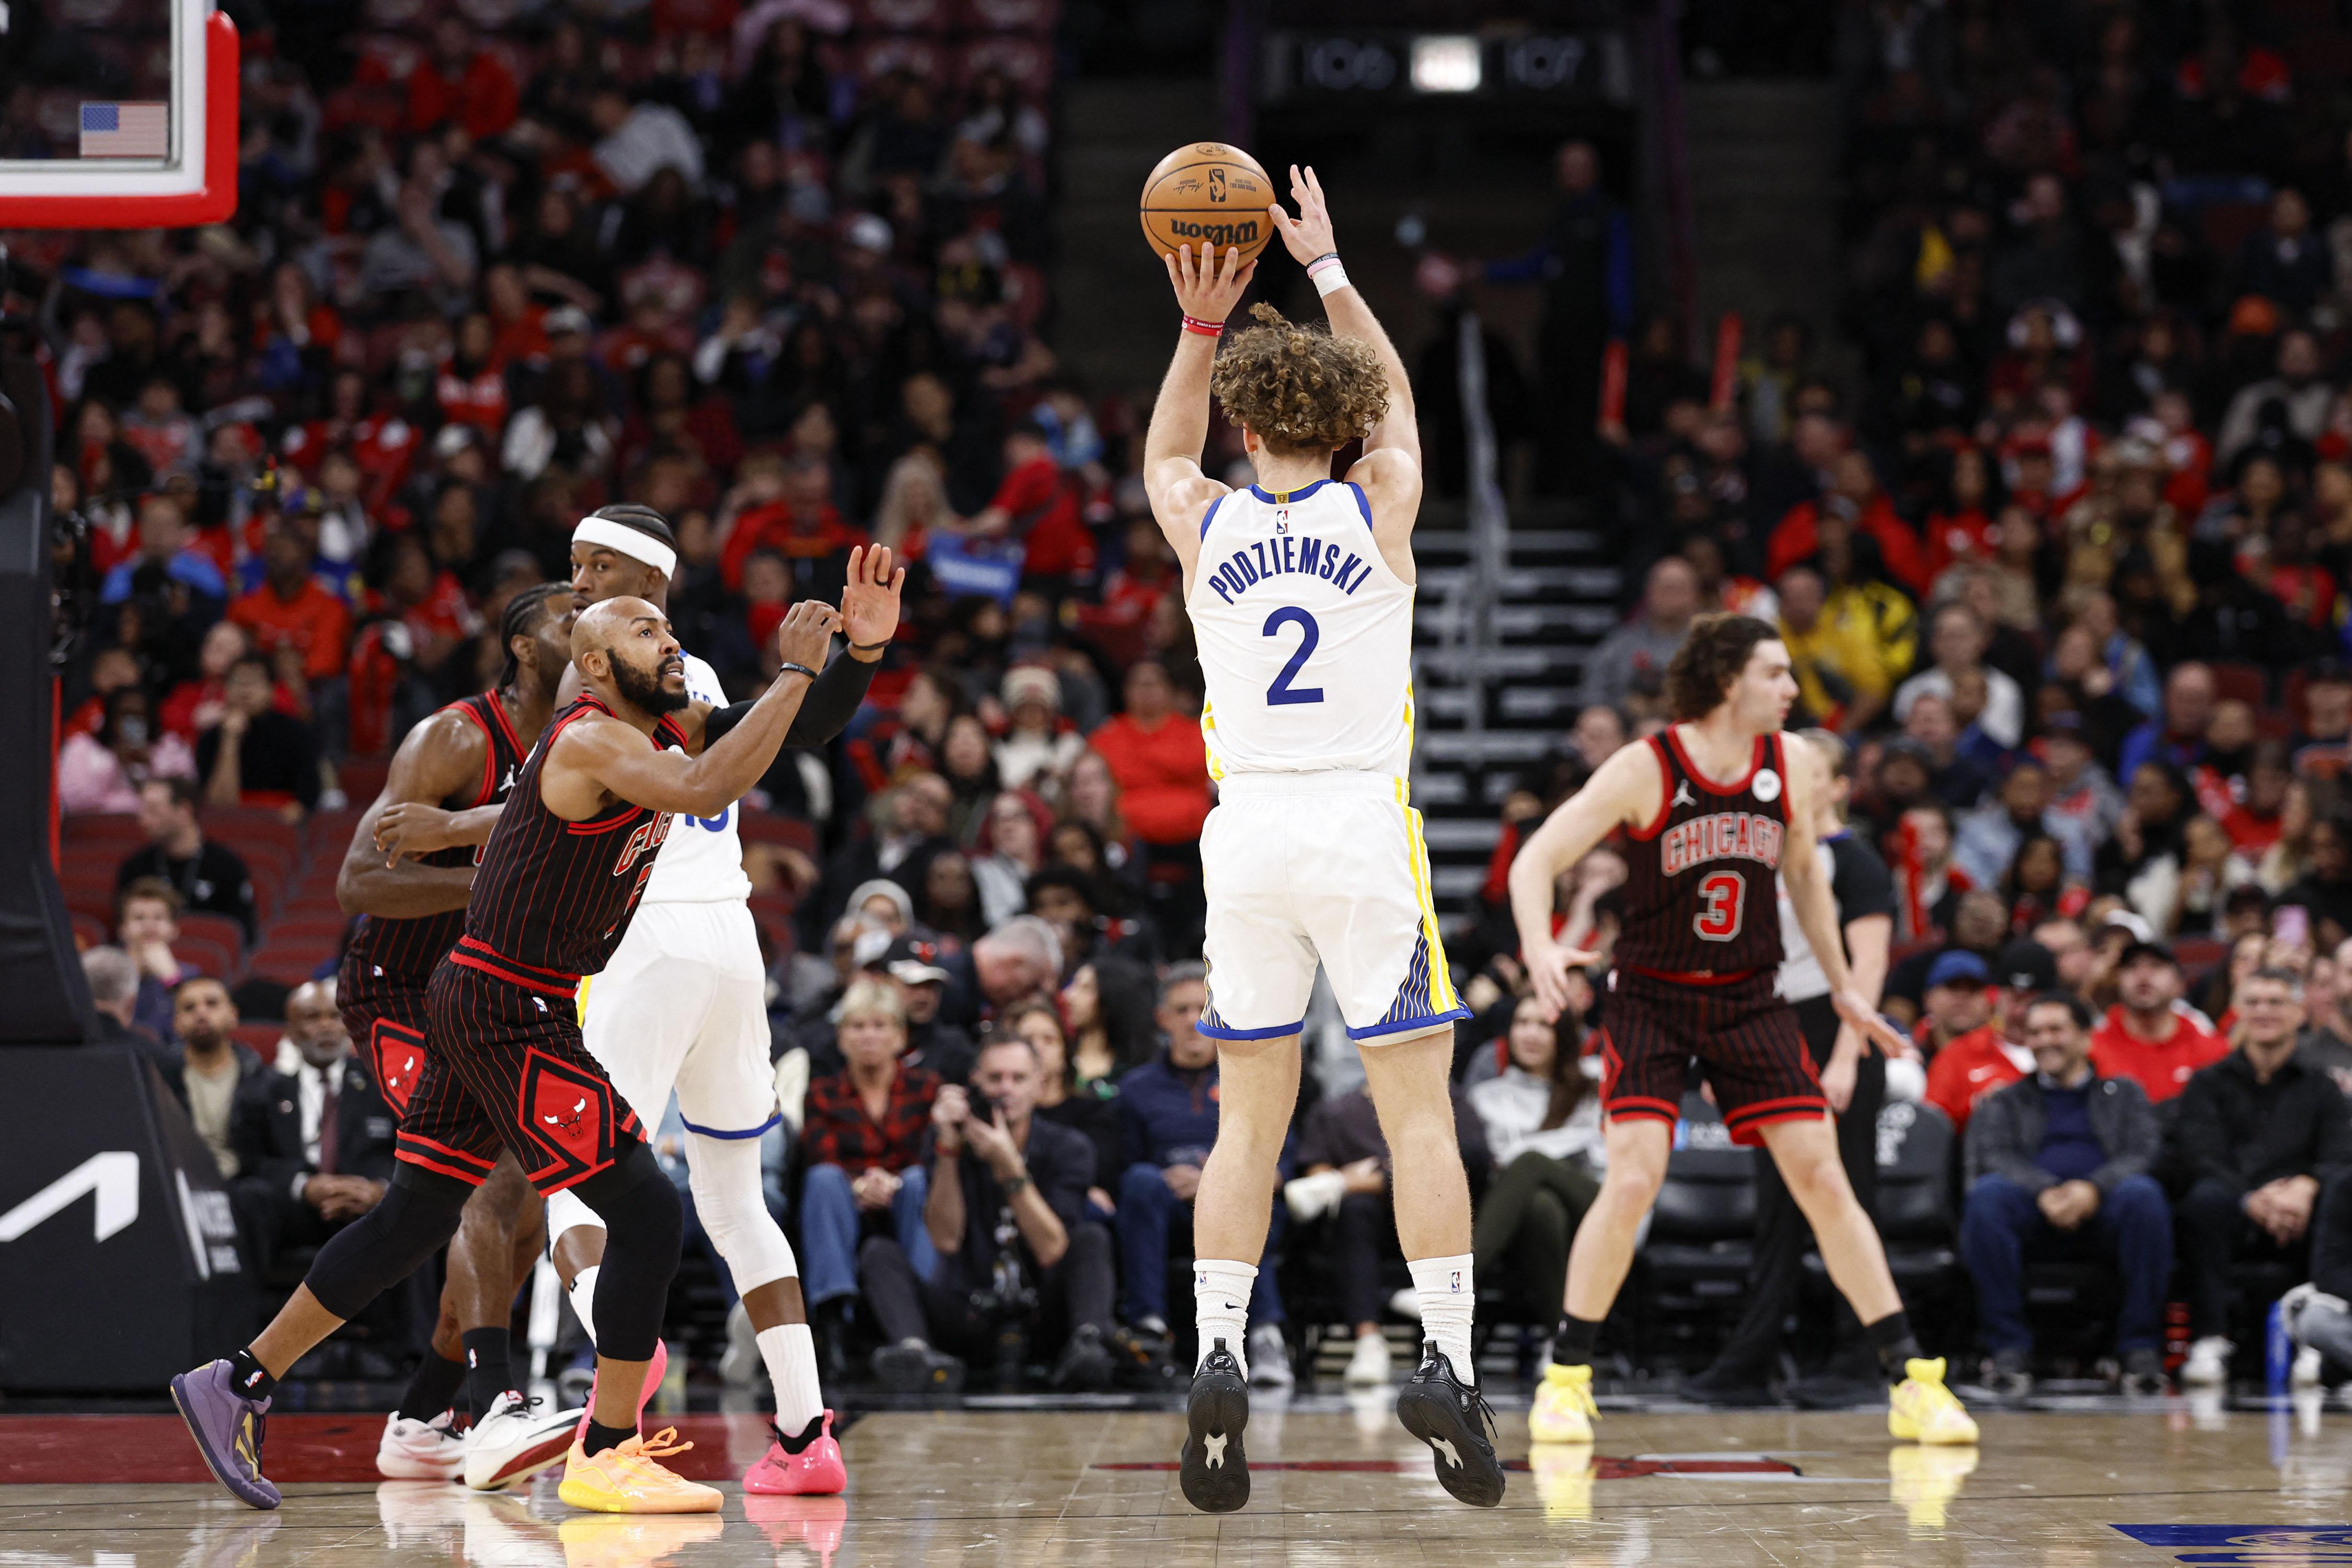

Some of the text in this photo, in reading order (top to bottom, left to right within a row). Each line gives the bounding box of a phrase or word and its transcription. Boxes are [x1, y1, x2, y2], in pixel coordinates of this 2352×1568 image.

[1170, 218, 1259, 247] Wilson
[1208, 536, 1373, 605] PODZIEMSKI
[1262, 606, 1324, 706] 2
[1693, 870, 1746, 942] 3
